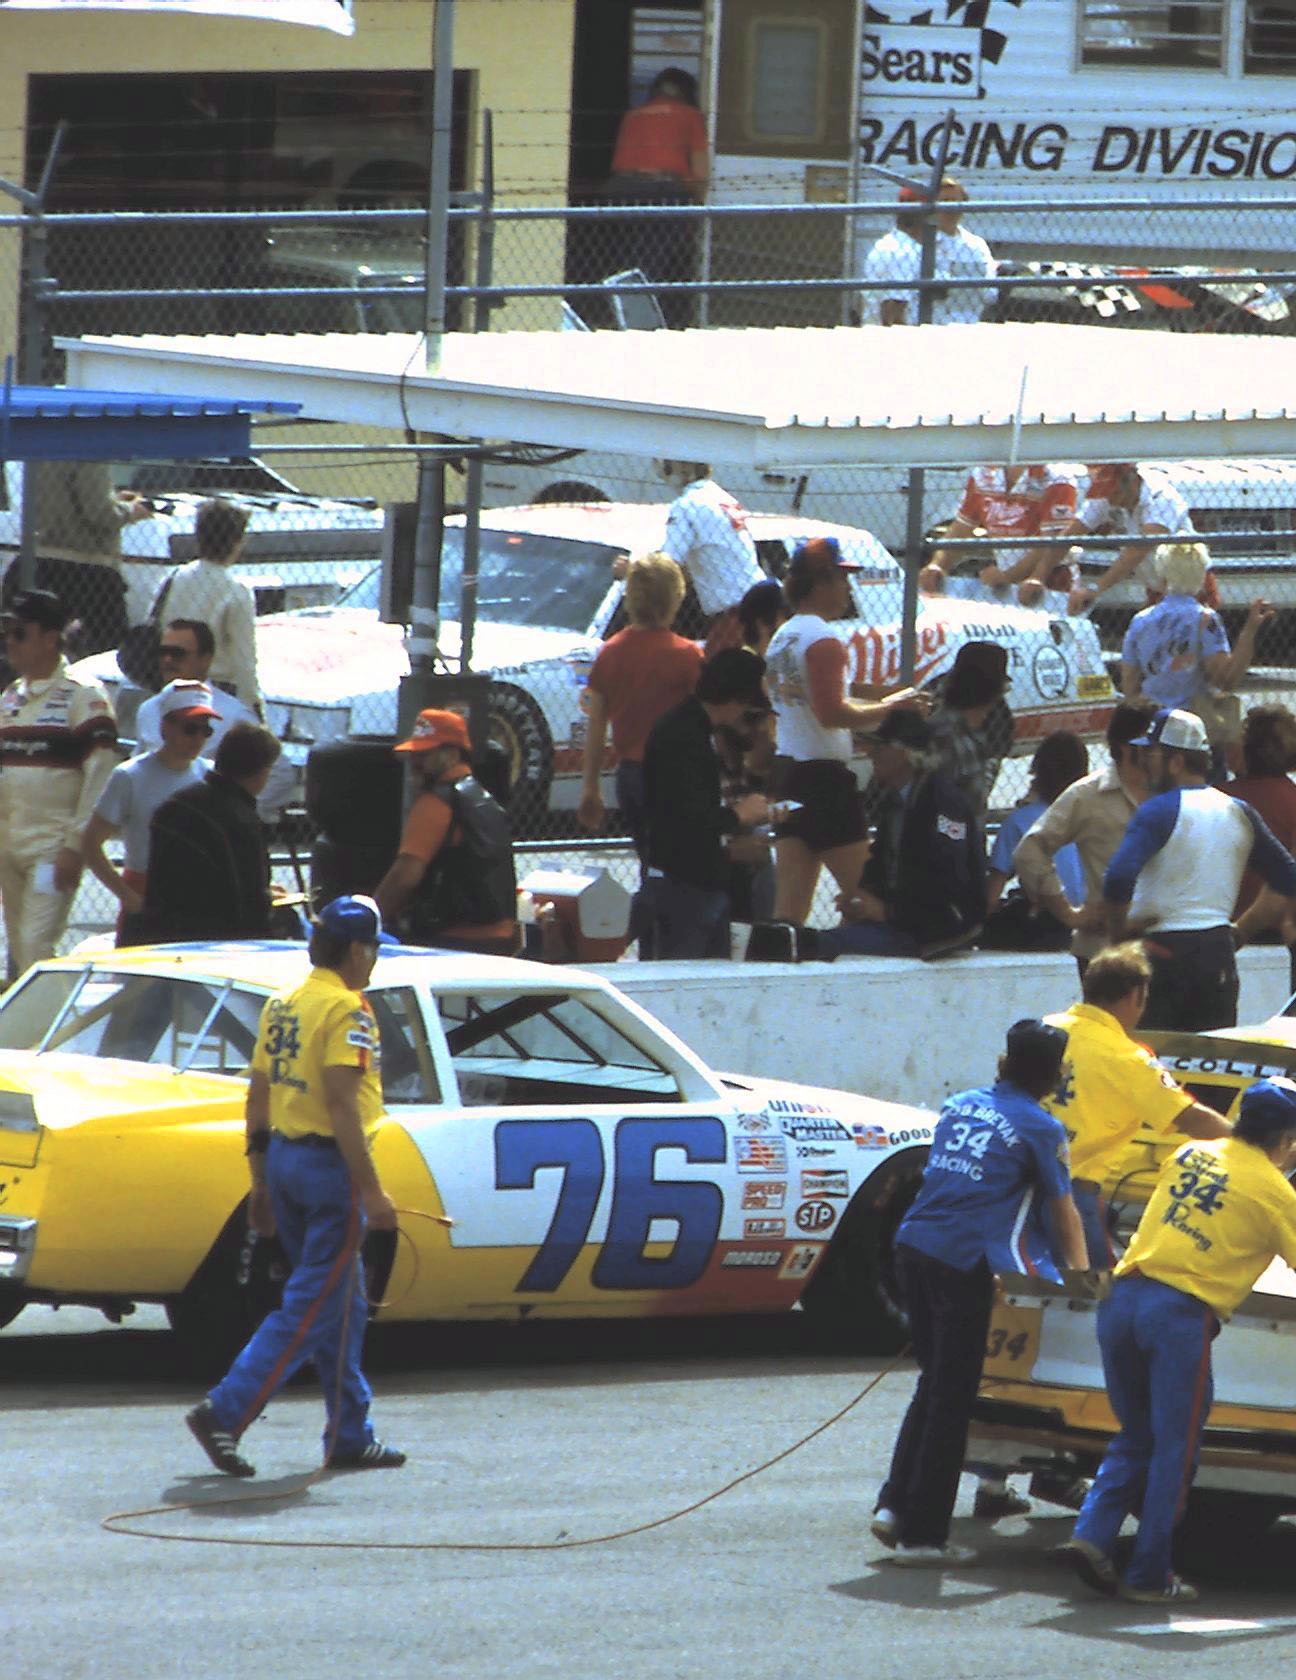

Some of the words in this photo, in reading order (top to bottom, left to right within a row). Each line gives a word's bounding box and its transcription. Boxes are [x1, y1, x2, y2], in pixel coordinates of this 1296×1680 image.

[862, 34, 974, 85] Sears
[859, 118, 1069, 172] RACING
[264, 1024, 301, 1058] 34
[944, 1121, 993, 1159] 34
[973, 1106, 1021, 1149] BREVAK
[494, 1116, 727, 1292] 76
[798, 1202, 833, 1229] STP
[1169, 1171, 1228, 1216] 34
